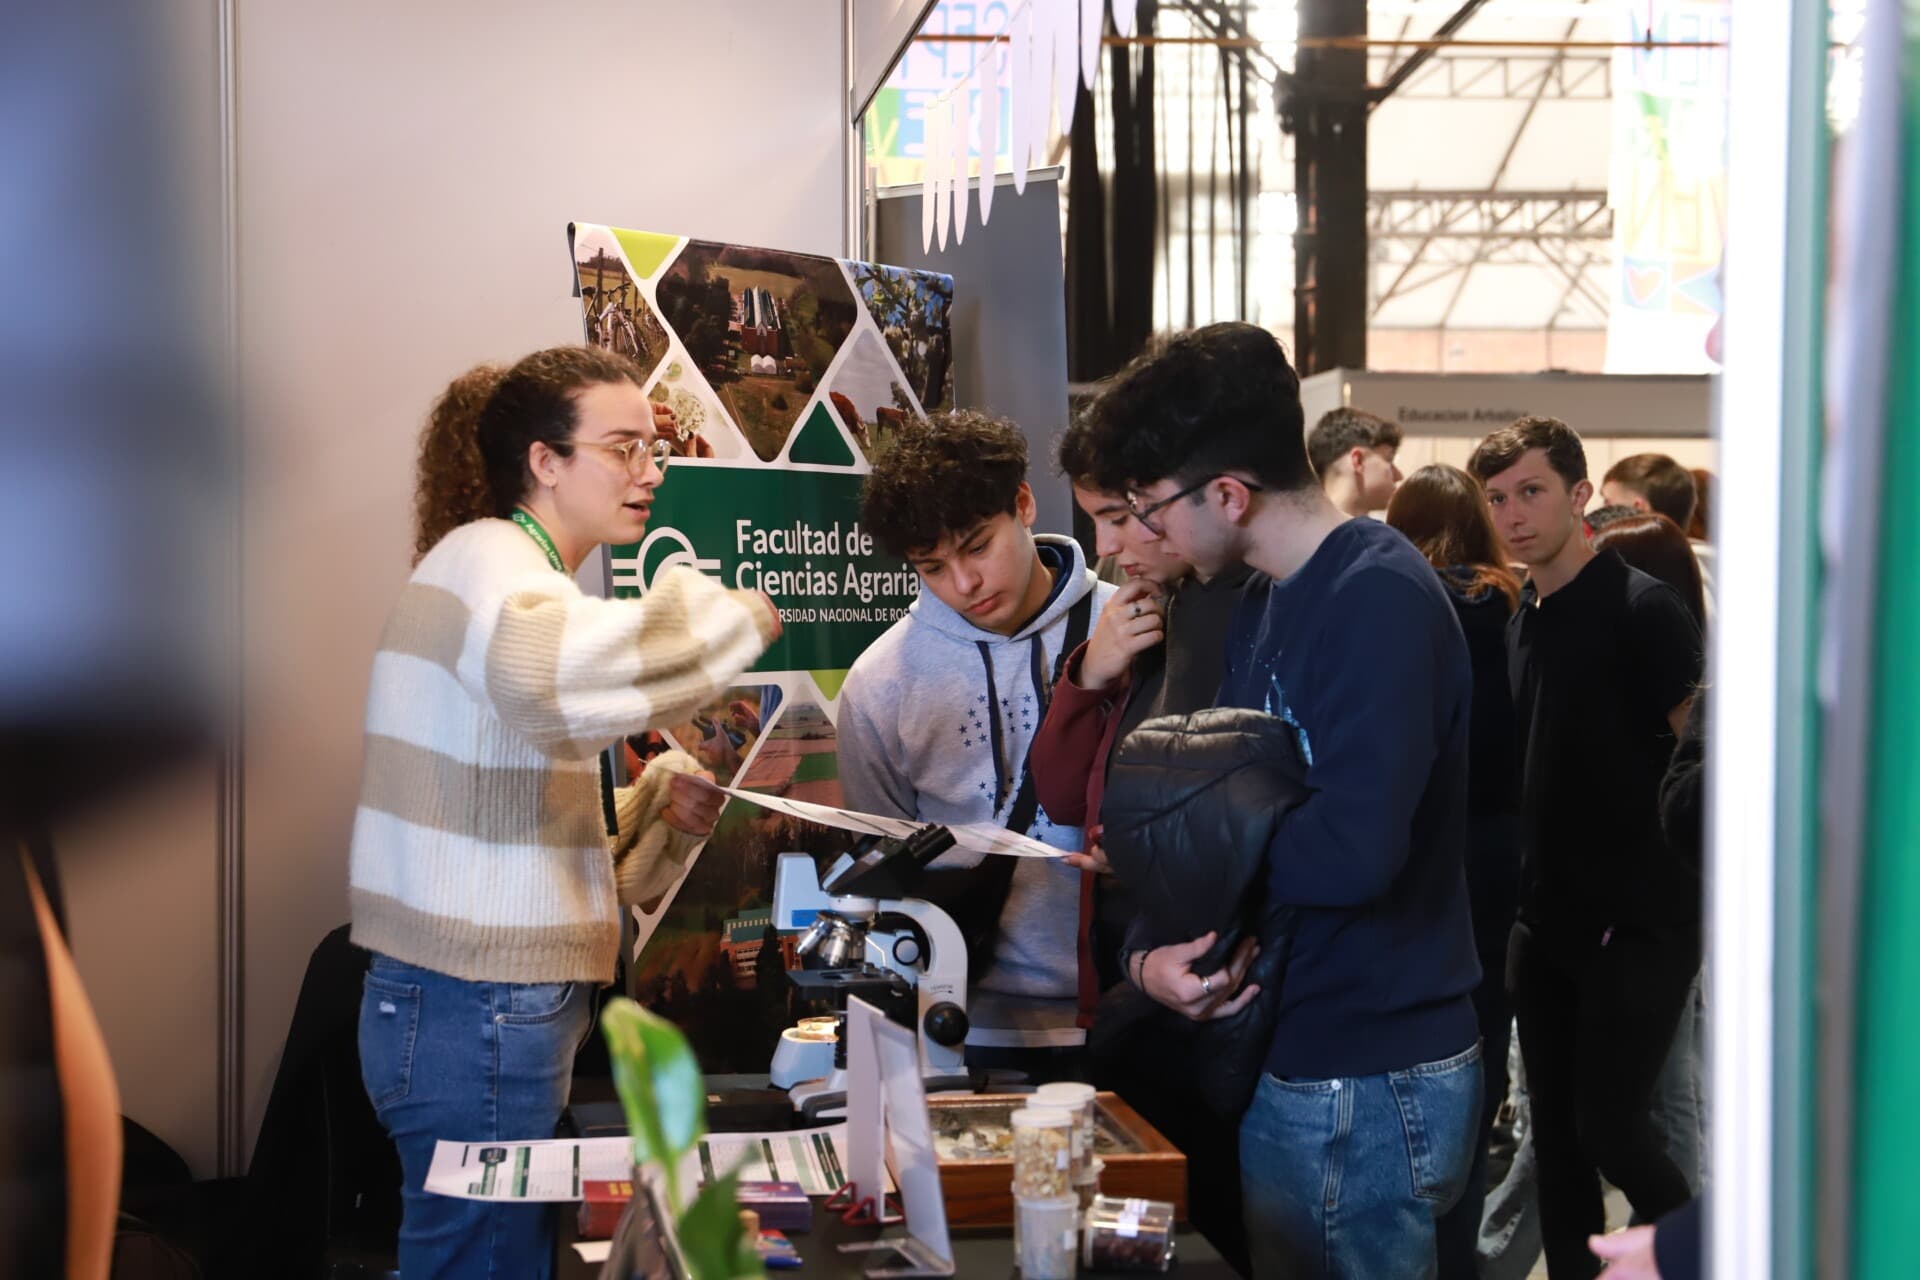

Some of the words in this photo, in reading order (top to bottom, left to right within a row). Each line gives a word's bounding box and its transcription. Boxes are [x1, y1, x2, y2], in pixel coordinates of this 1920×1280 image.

[736, 519, 840, 556] Facultad
[846, 522, 873, 556] de
[736, 561, 837, 597] Ciencias
[843, 563, 921, 603] Agraria
[777, 607, 816, 623] RSIDAD
[820, 607, 873, 622] NACIONAL
[874, 607, 888, 621] DE
[890, 607, 910, 621] ROS
